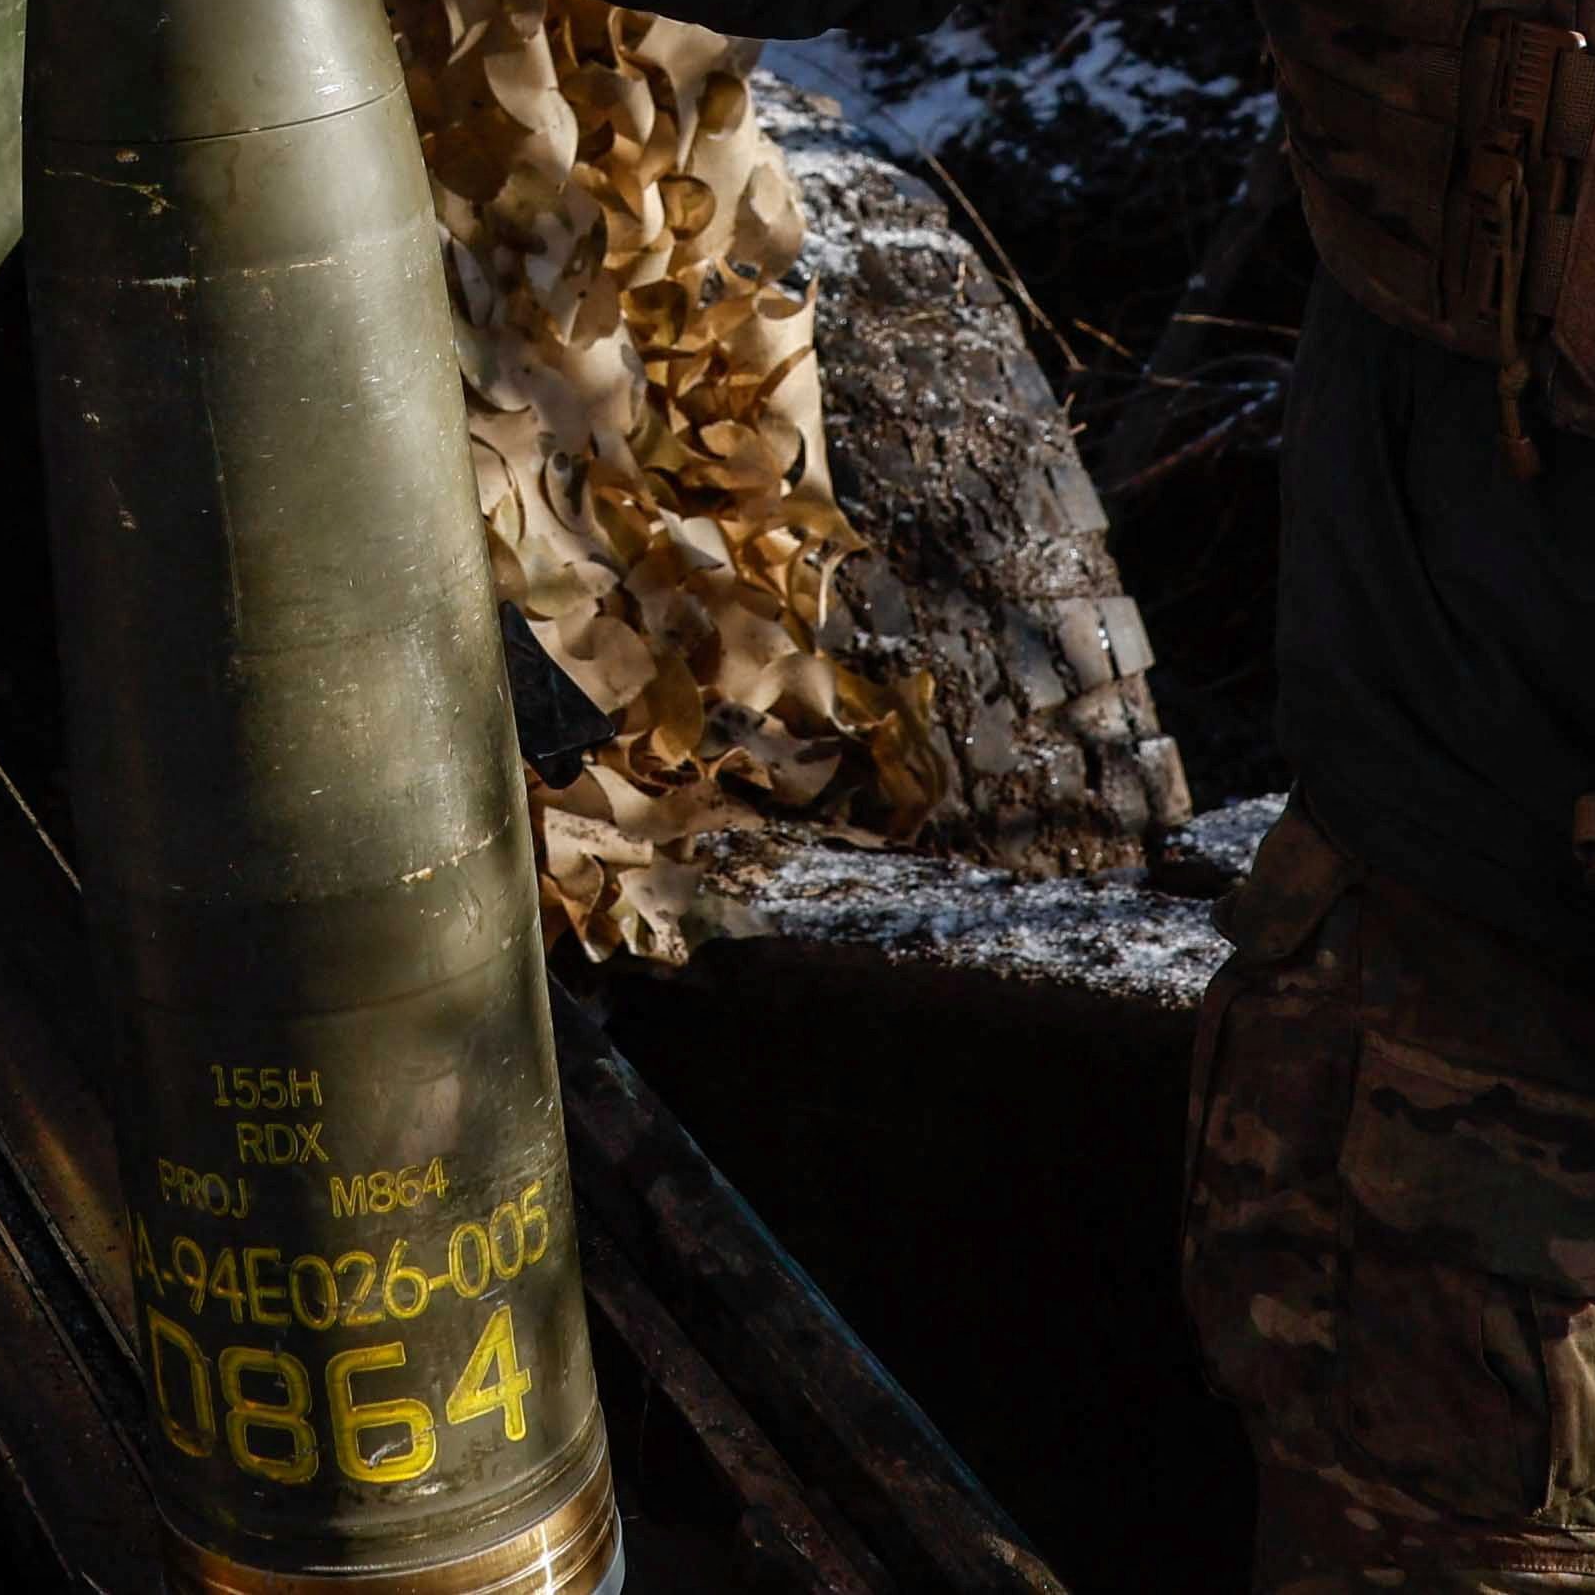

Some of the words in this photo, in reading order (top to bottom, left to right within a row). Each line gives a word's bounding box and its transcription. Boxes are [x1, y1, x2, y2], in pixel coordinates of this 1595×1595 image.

[210, 1064, 323, 1110] 155H
[235, 1122, 330, 1165] RDX
[157, 1157, 250, 1220] PROJ
[328, 1156, 450, 1218] M864
